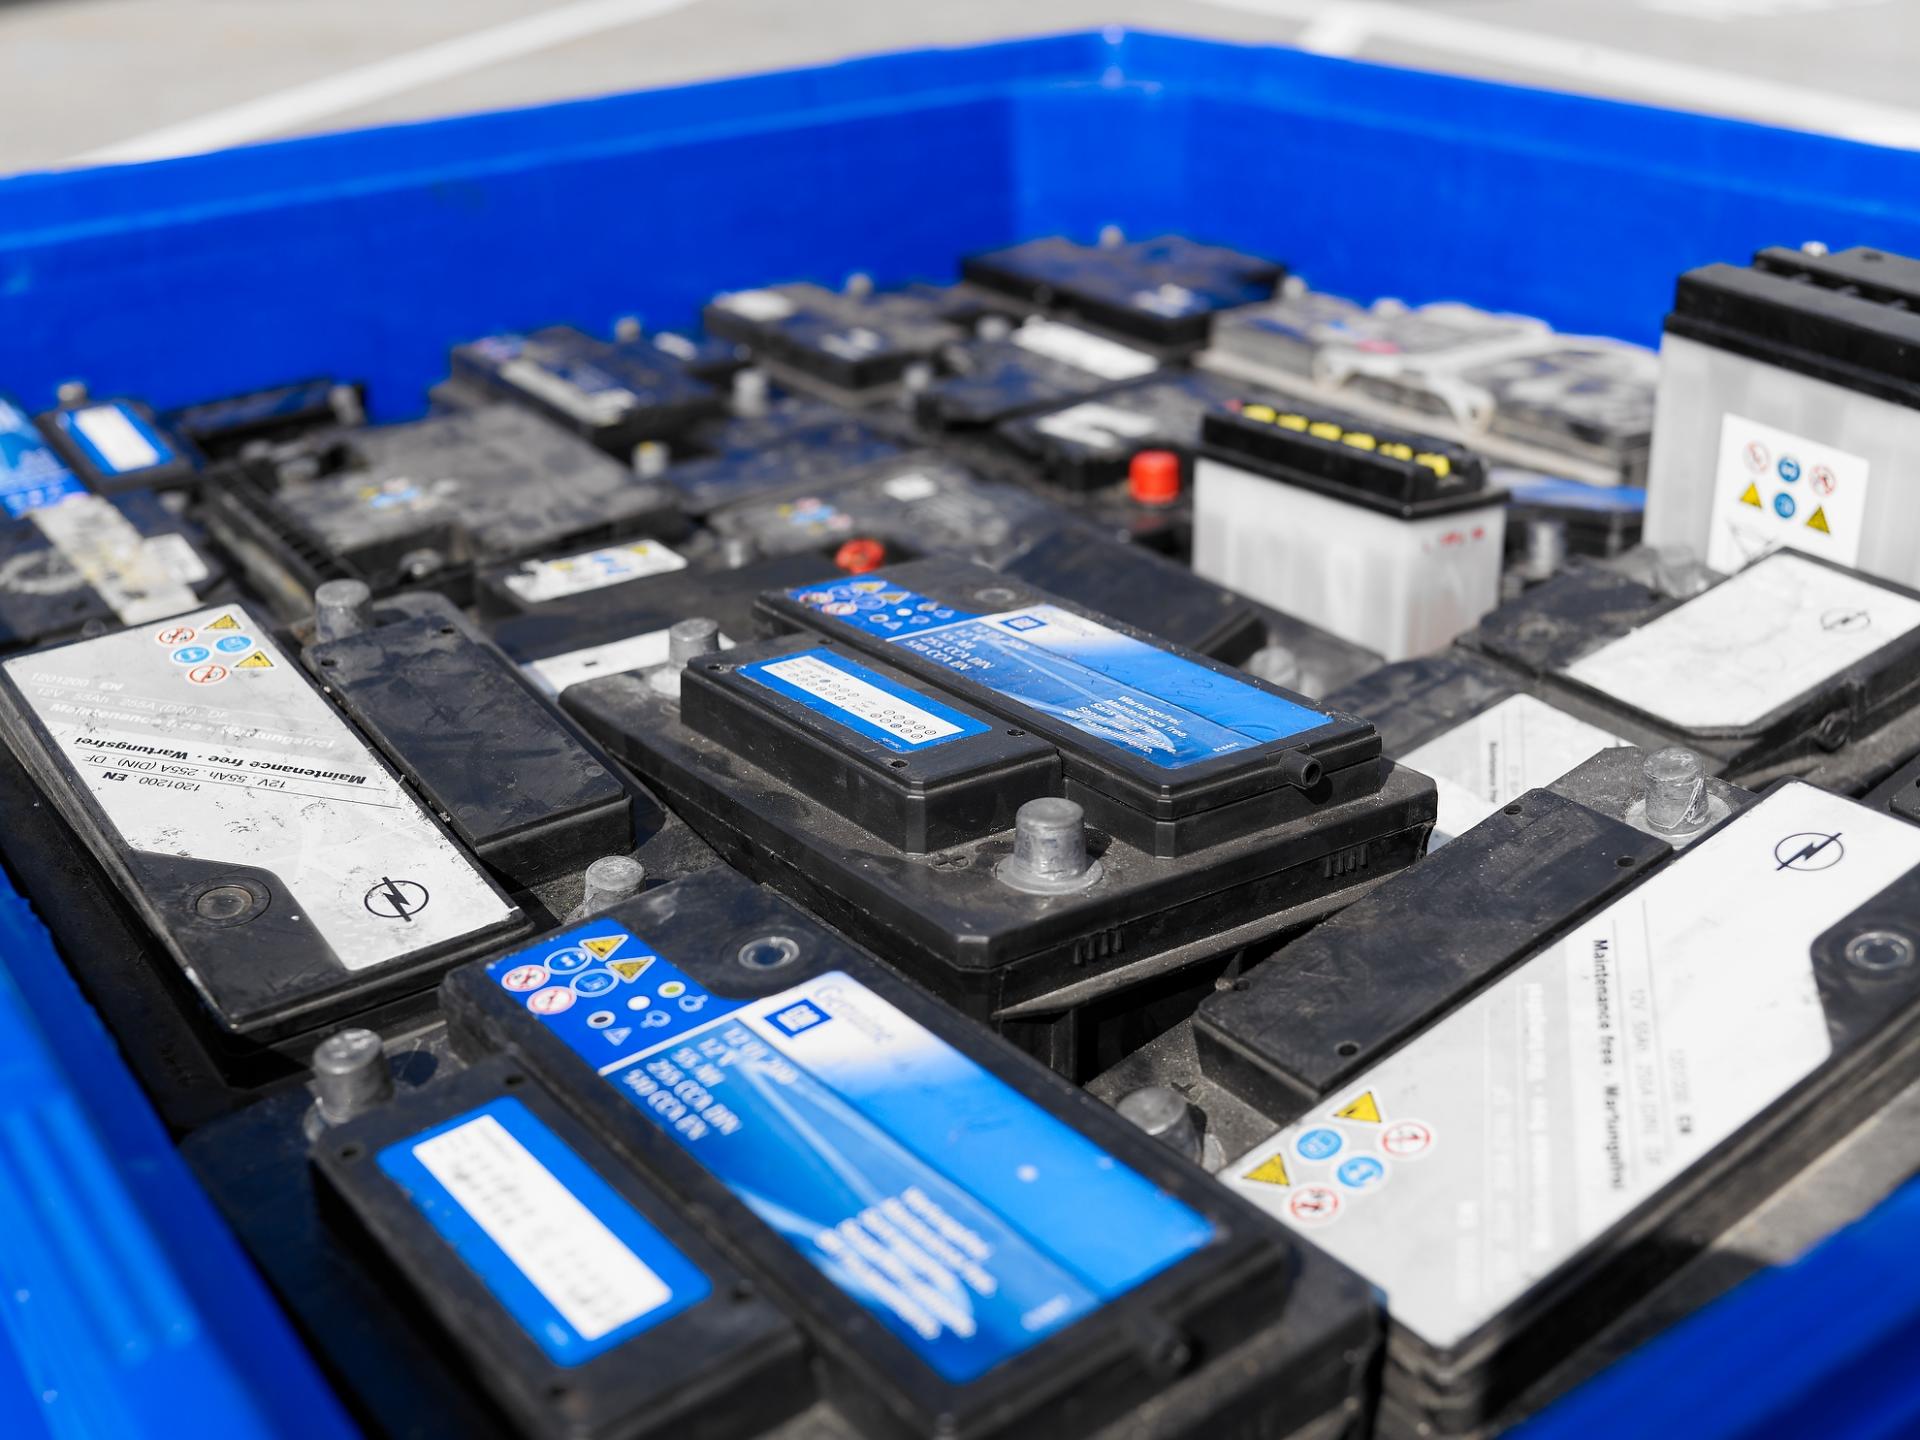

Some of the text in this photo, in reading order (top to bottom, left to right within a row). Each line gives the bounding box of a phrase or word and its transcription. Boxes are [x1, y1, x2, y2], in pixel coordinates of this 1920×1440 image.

[926, 649, 953, 663] CCA
[949, 660, 972, 670] EN
[943, 646, 971, 659] CCA
[31, 672, 125, 692] 1201200 EN
[37, 687, 65, 698] 12V
[120, 699, 156, 711] 255A
[158, 703, 197, 716] (DIN)
[1090, 702, 1115, 717] Sans
[49, 703, 162, 725] Maintenance
[220, 725, 336, 750] Wartungsfrei
[74, 736, 367, 785] Maintenance free Wartungsfrei
[84, 754, 286, 789] 12V 55Ah 255A (DIN) DF
[102, 771, 201, 792] 1201200 EN
[1592, 939, 1610, 1029] Maintenance
[1600, 1035, 1615, 1065] free
